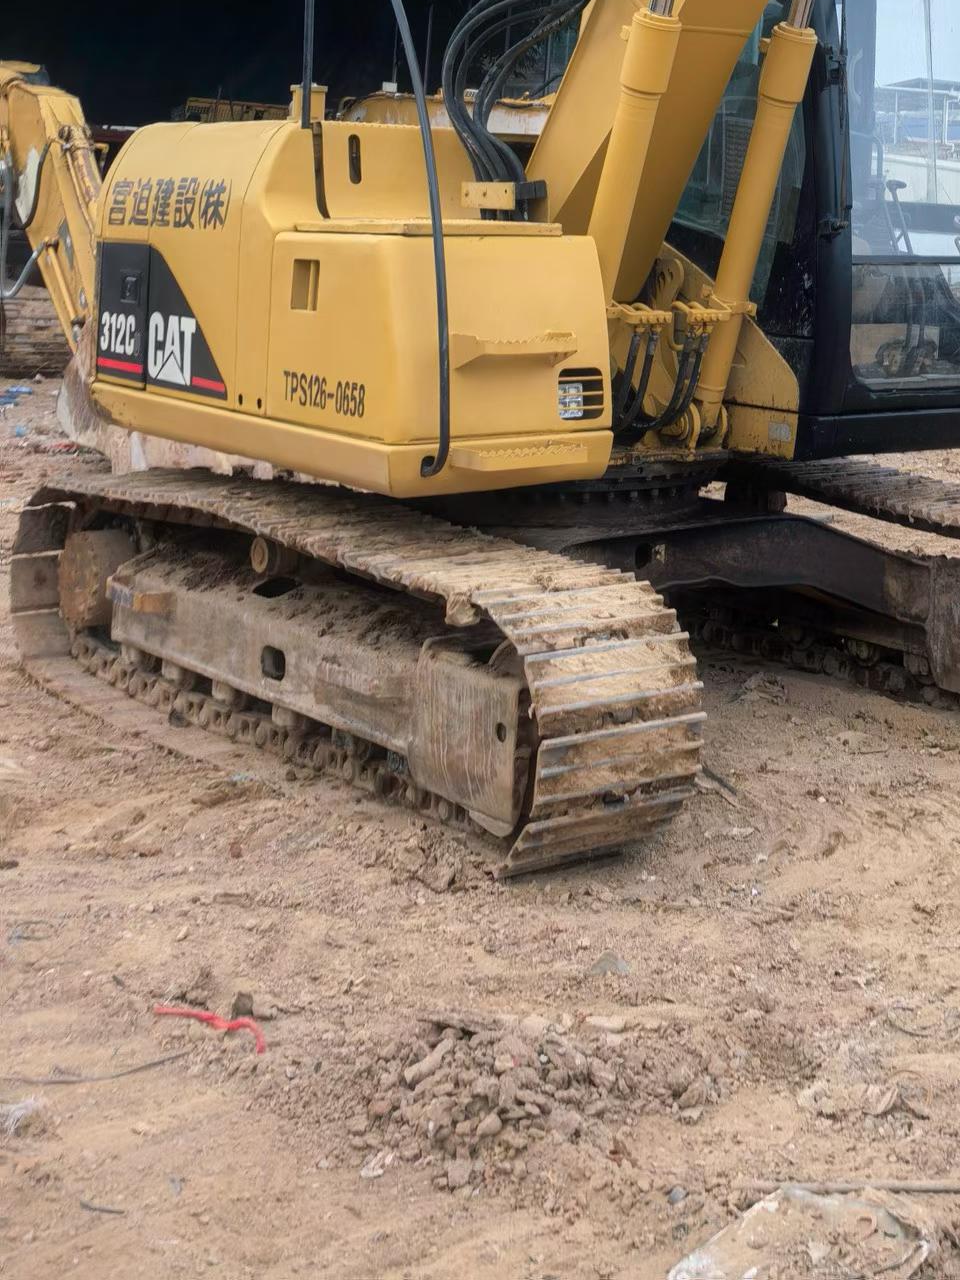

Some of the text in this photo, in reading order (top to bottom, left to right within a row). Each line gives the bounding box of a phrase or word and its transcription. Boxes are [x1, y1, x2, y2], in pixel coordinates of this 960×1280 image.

[100, 311, 136, 356] 312C
[147, 311, 197, 387] CAT
[283, 370, 366, 419] TPS126-0658
